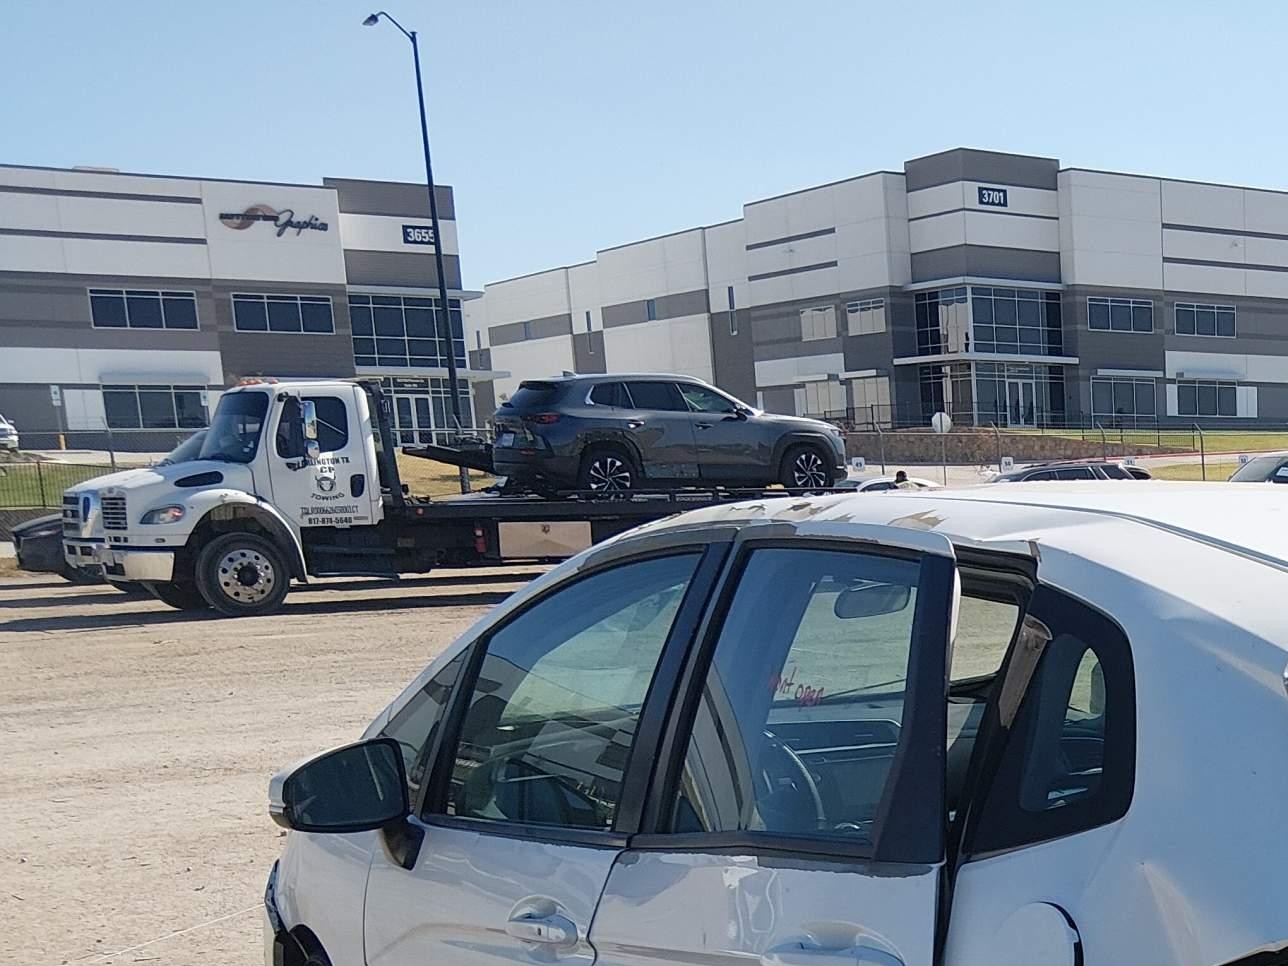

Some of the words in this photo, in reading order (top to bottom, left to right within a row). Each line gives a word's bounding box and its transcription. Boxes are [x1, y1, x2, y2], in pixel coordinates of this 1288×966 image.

[981, 189, 1004, 205] 3701
[406, 228, 435, 242] 3655
[319, 466, 335, 474] CP
[310, 492, 345, 501] TOWING
